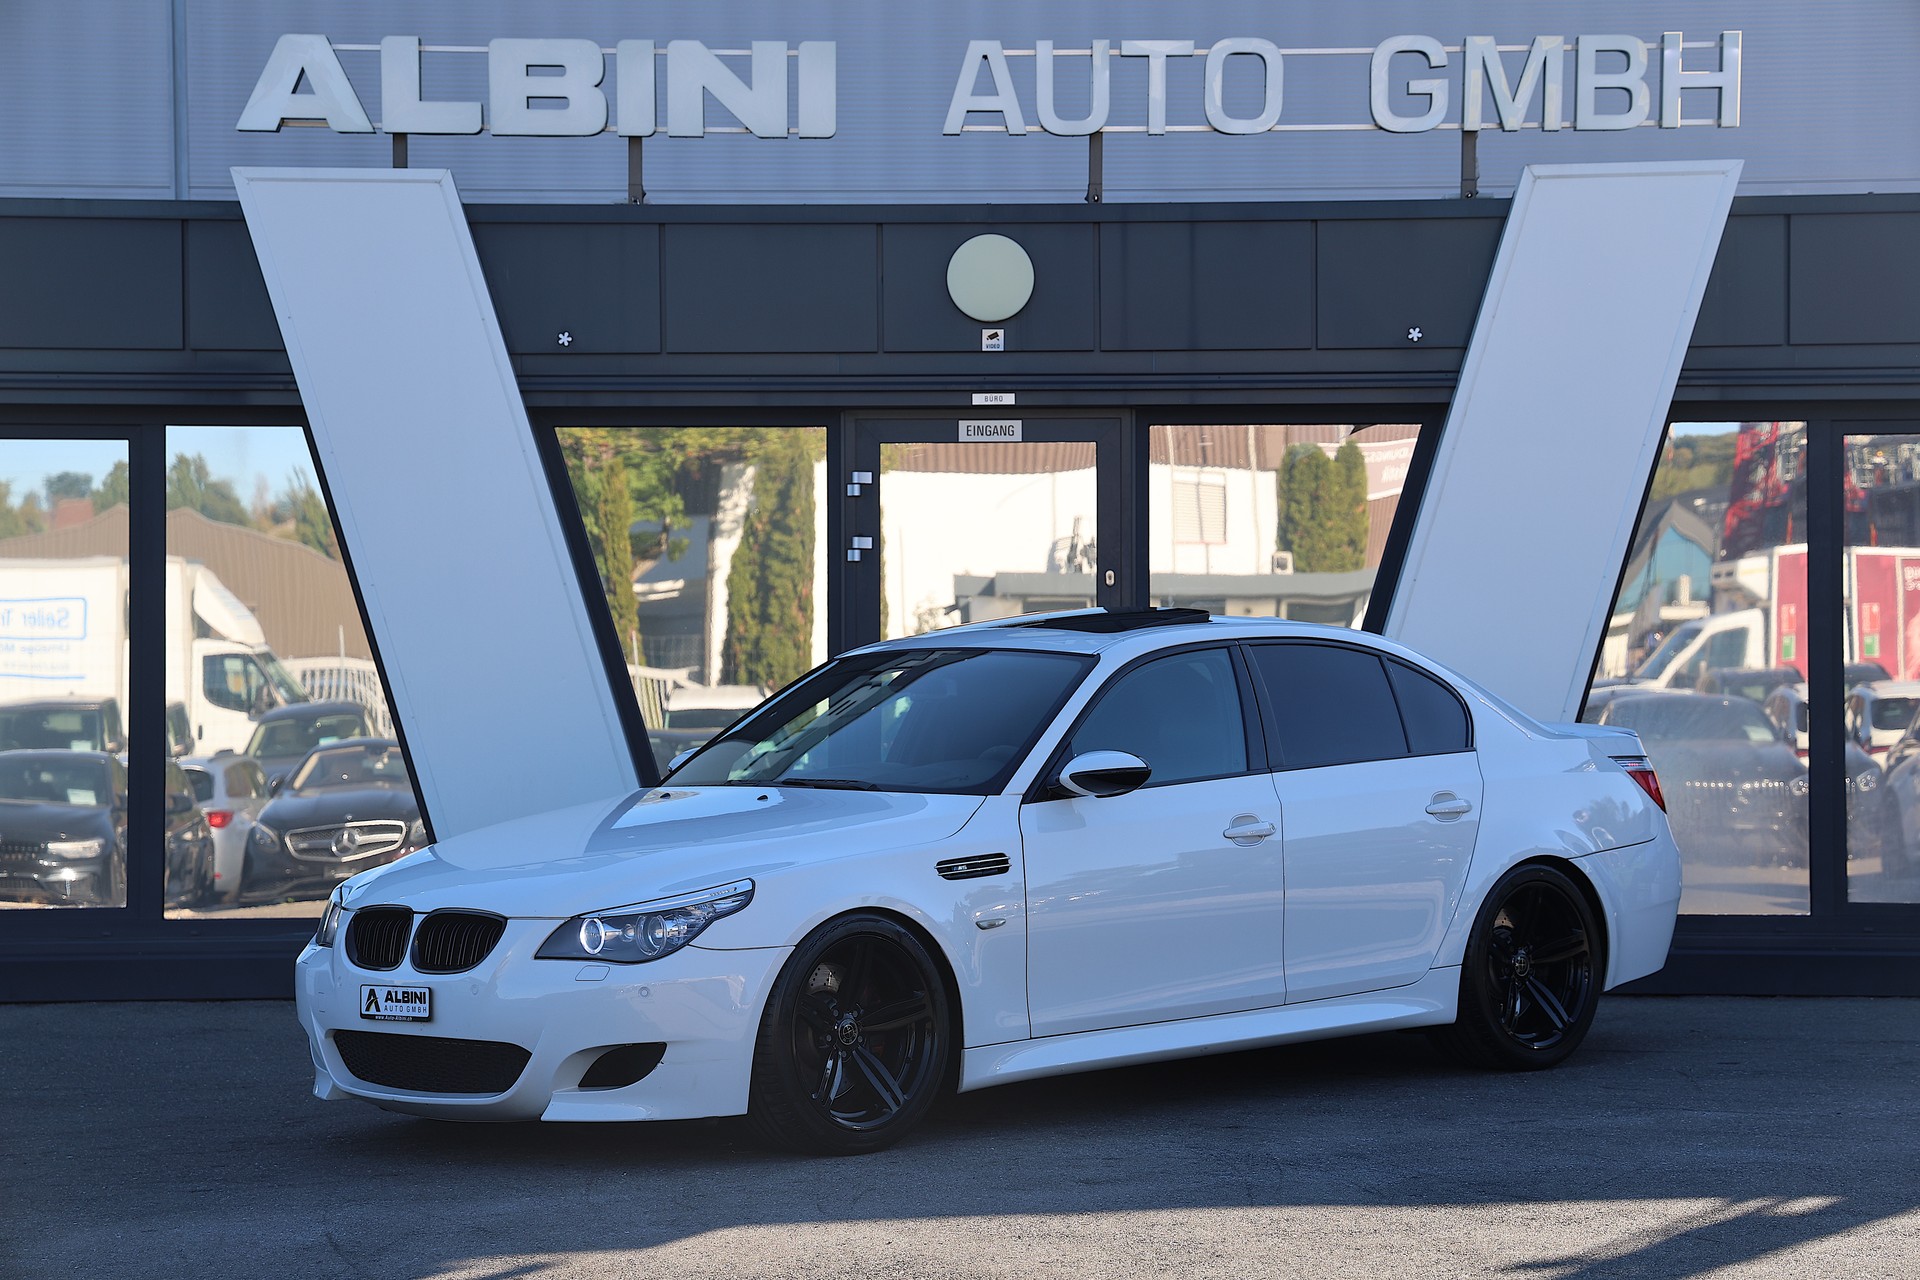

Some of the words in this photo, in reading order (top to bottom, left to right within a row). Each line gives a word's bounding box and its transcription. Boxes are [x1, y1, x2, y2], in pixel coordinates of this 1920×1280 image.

[236, 33, 837, 139] ALBINI
[943, 37, 1284, 137] AUTO
[1369, 31, 1742, 133] GMBH
[966, 424, 1015, 437] EINGANG
[384, 990, 427, 1004] ALBINI
[384, 1005, 403, 1013] AUTO
